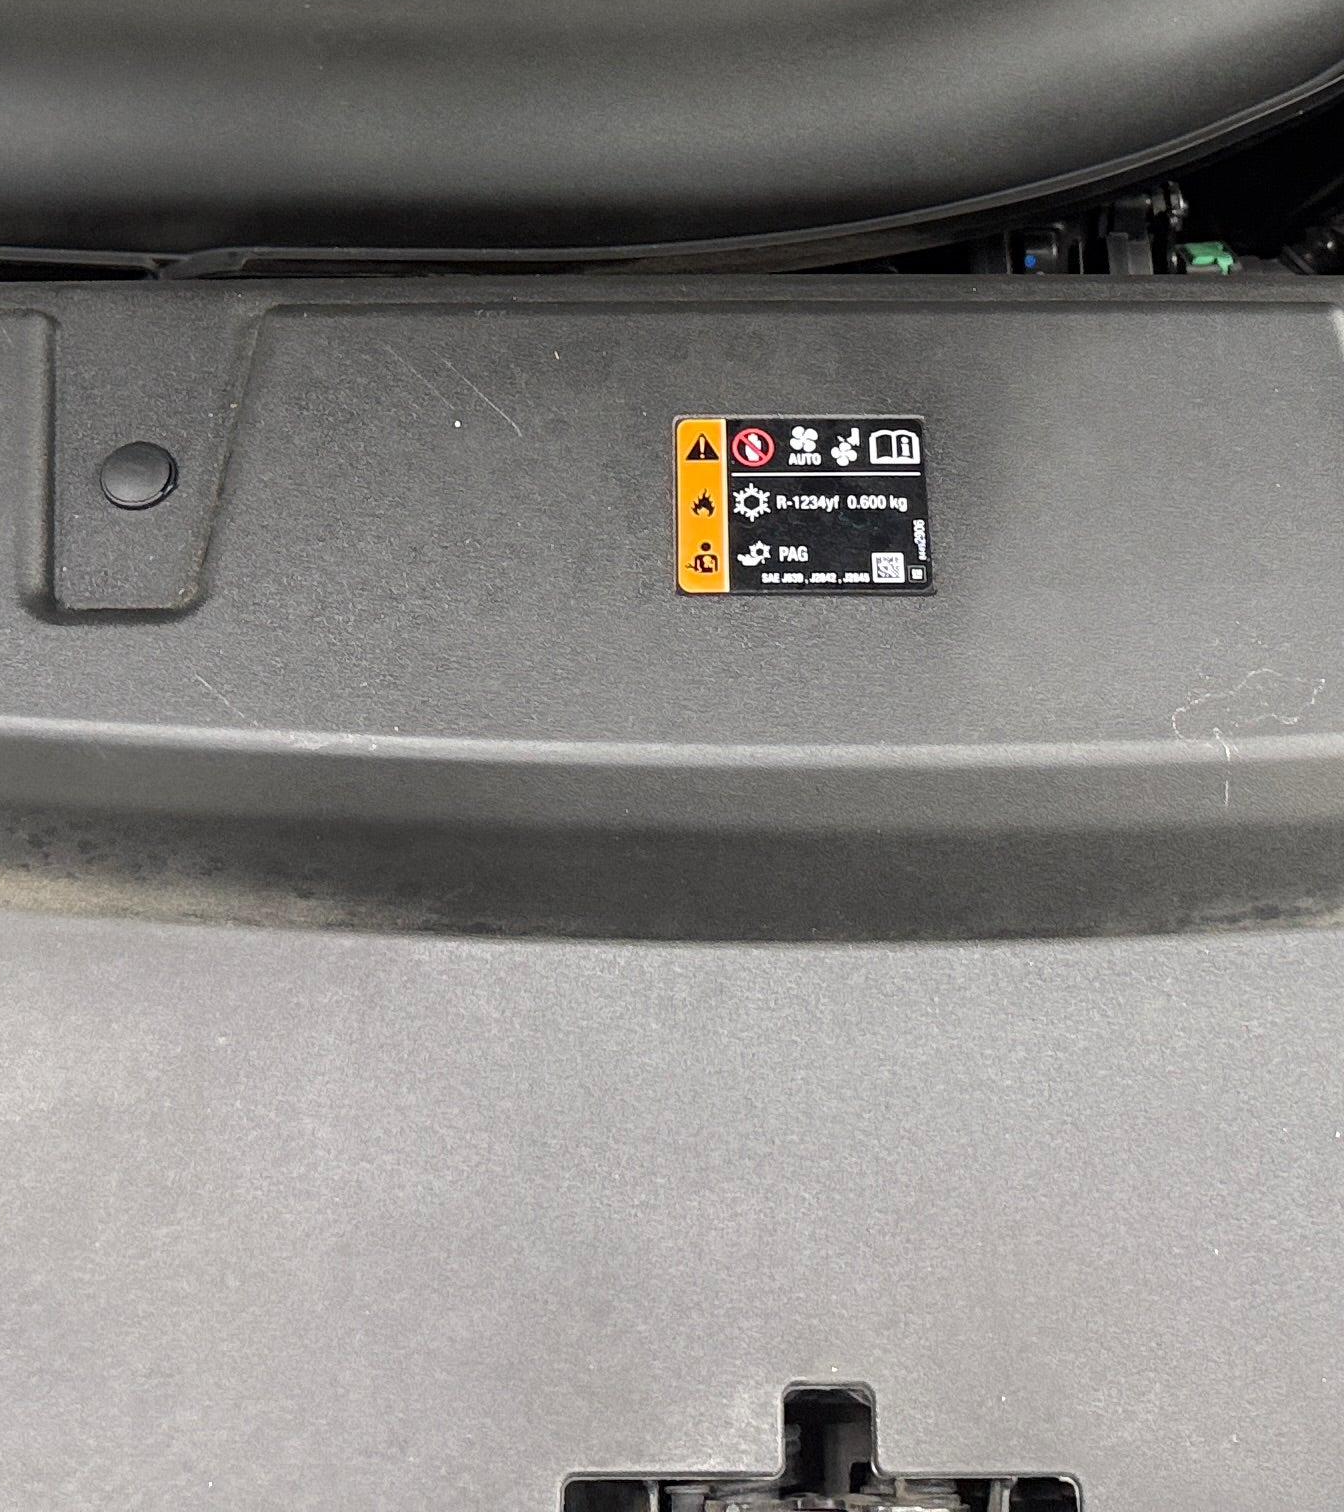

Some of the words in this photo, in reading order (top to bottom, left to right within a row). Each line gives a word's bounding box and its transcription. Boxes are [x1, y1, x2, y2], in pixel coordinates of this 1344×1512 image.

[788, 452, 822, 466] AUTO
[775, 494, 840, 511] R-1234yf
[846, 495, 886, 510] 0.600
[889, 495, 908, 512] kg
[778, 545, 809, 562] PAG
